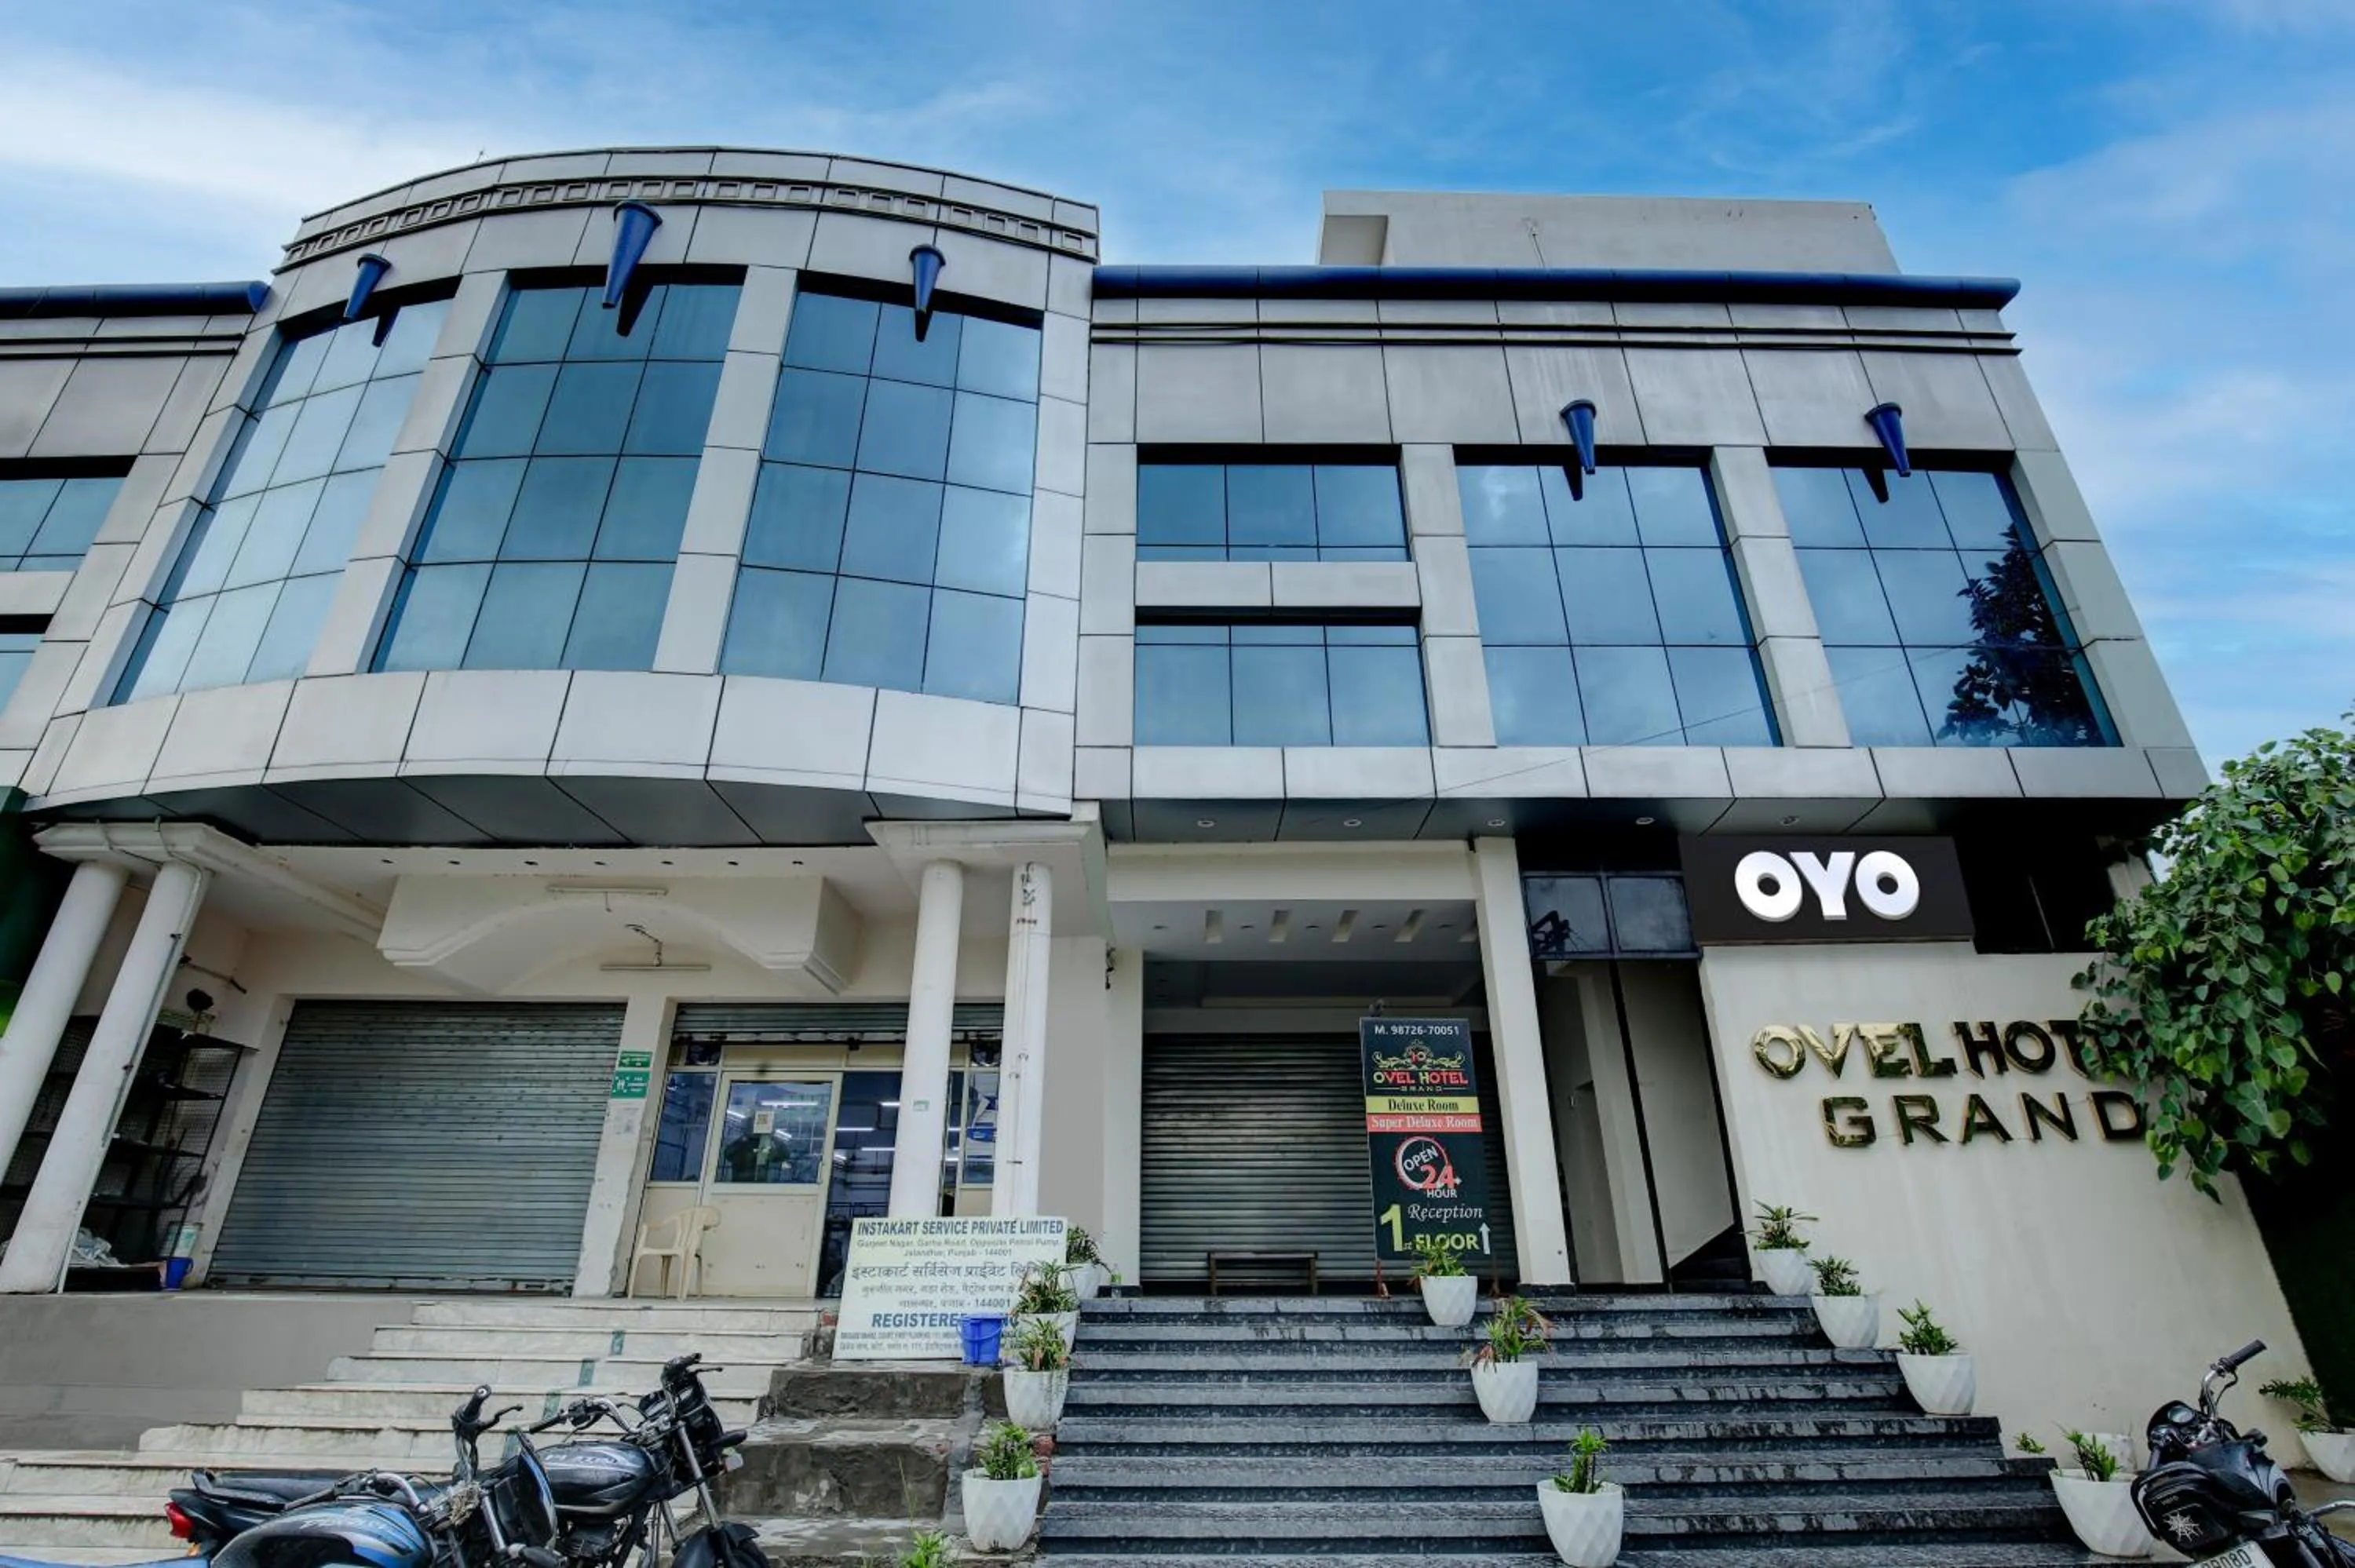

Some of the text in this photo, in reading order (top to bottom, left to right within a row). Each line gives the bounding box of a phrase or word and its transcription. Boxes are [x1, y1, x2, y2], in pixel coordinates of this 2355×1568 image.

[1734, 850, 1920, 922] OYO
[1375, 1026, 1460, 1036] M. 98726-70051
[1373, 1071, 1469, 1085] OVEL HOTEL
[1388, 1099, 1459, 1111] Deluxe Room
[1371, 1114, 1478, 1129] Super Deluxe Room
[1821, 1090, 2149, 1148] GRAND
[1404, 1146, 1439, 1172] OPEN
[1419, 1164, 1455, 1191] 24
[1426, 1188, 1458, 1198] HOUR
[1408, 1203, 1483, 1223] Reception
[857, 1220, 1064, 1235] INSTAKART SERVICE PRIVATE LIMITED
[1415, 1233, 1480, 1250] FLOOR
[975, 1298, 1011, 1308] 144001
